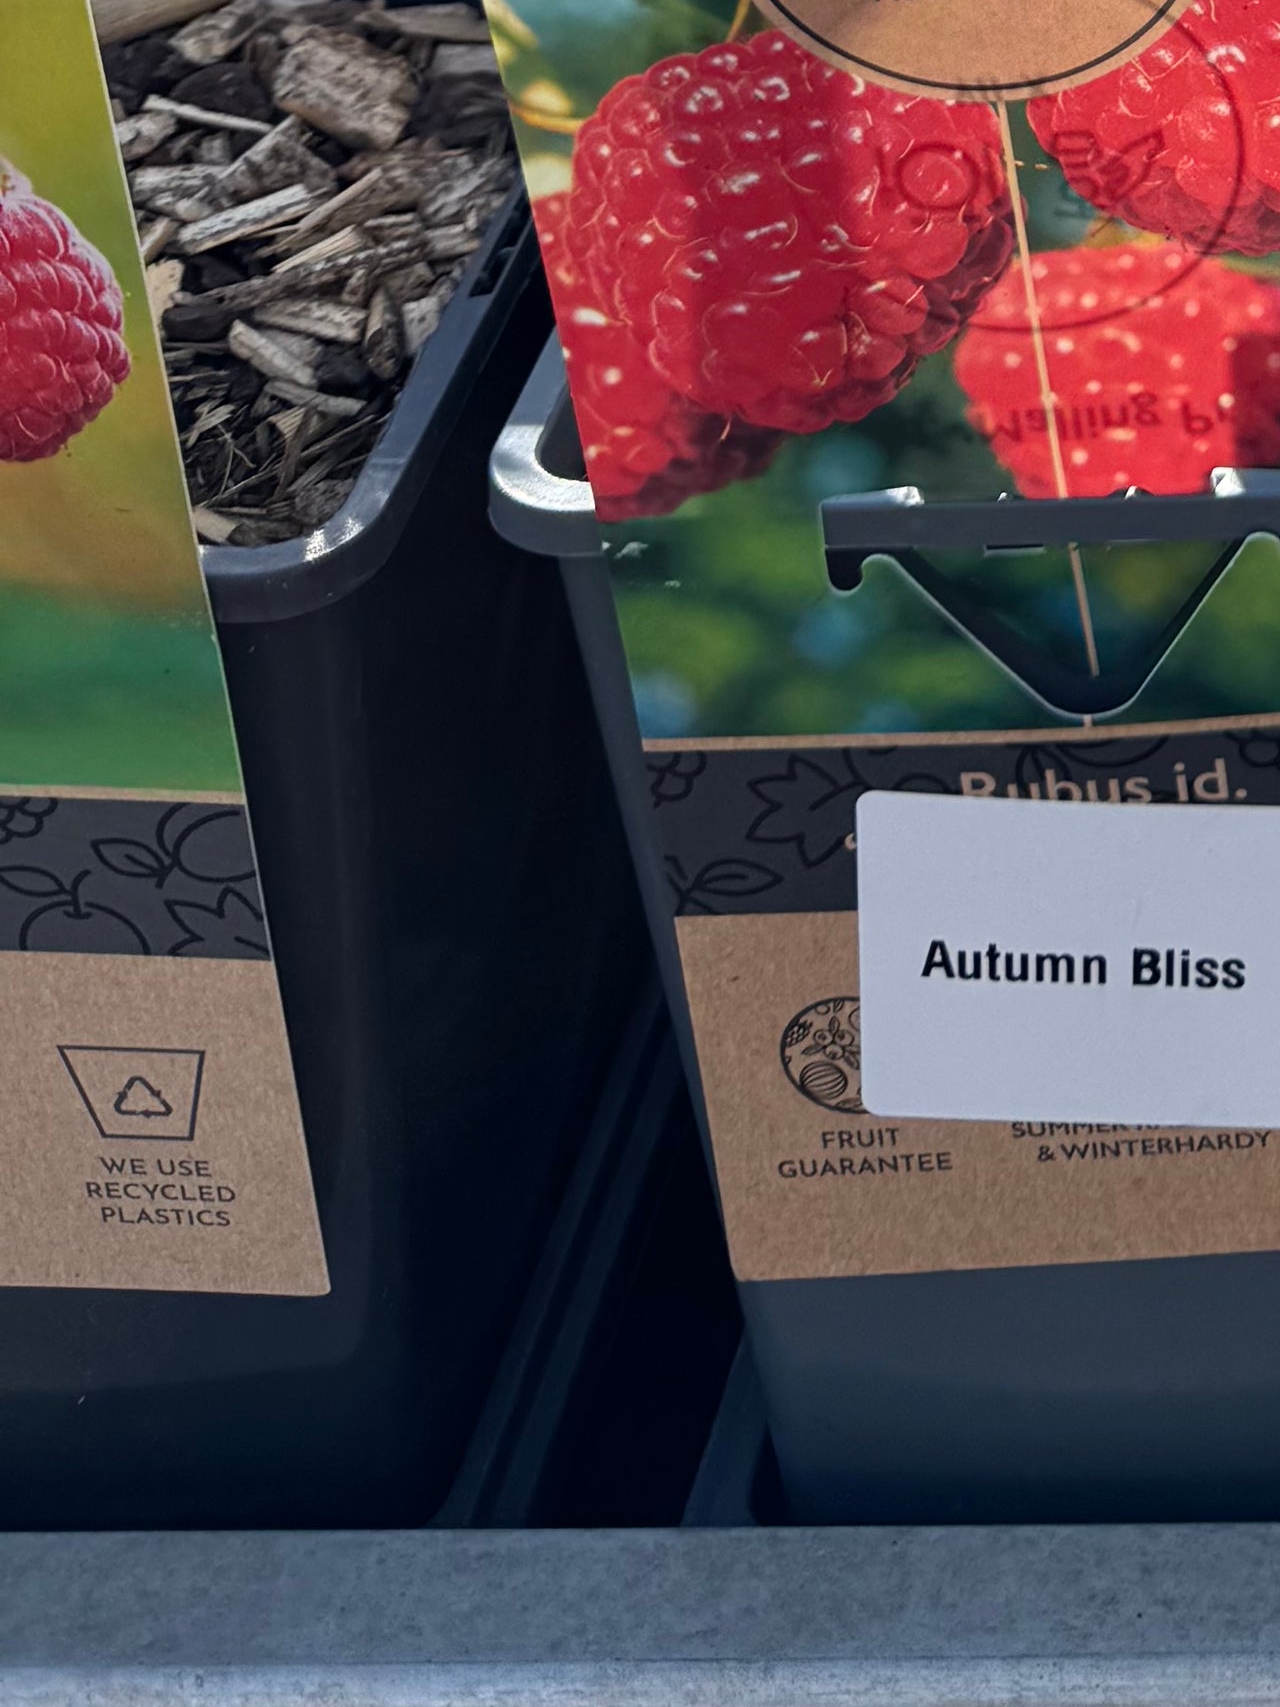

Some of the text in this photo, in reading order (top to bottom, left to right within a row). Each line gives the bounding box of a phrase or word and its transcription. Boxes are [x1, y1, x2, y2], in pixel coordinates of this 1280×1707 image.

[1174, 757, 1247, 801] id.
[921, 940, 1245, 989] Autumn Bliss
[822, 1127, 899, 1149] FRUIT
[1038, 1145, 1056, 1162] &
[1060, 1130, 1270, 1160] WINTERHARDY
[98, 1157, 212, 1178] WE USE
[778, 1152, 952, 1178] GUARANTEE
[86, 1182, 236, 1203] RECYCLED
[101, 1206, 230, 1227] PLASTICS
